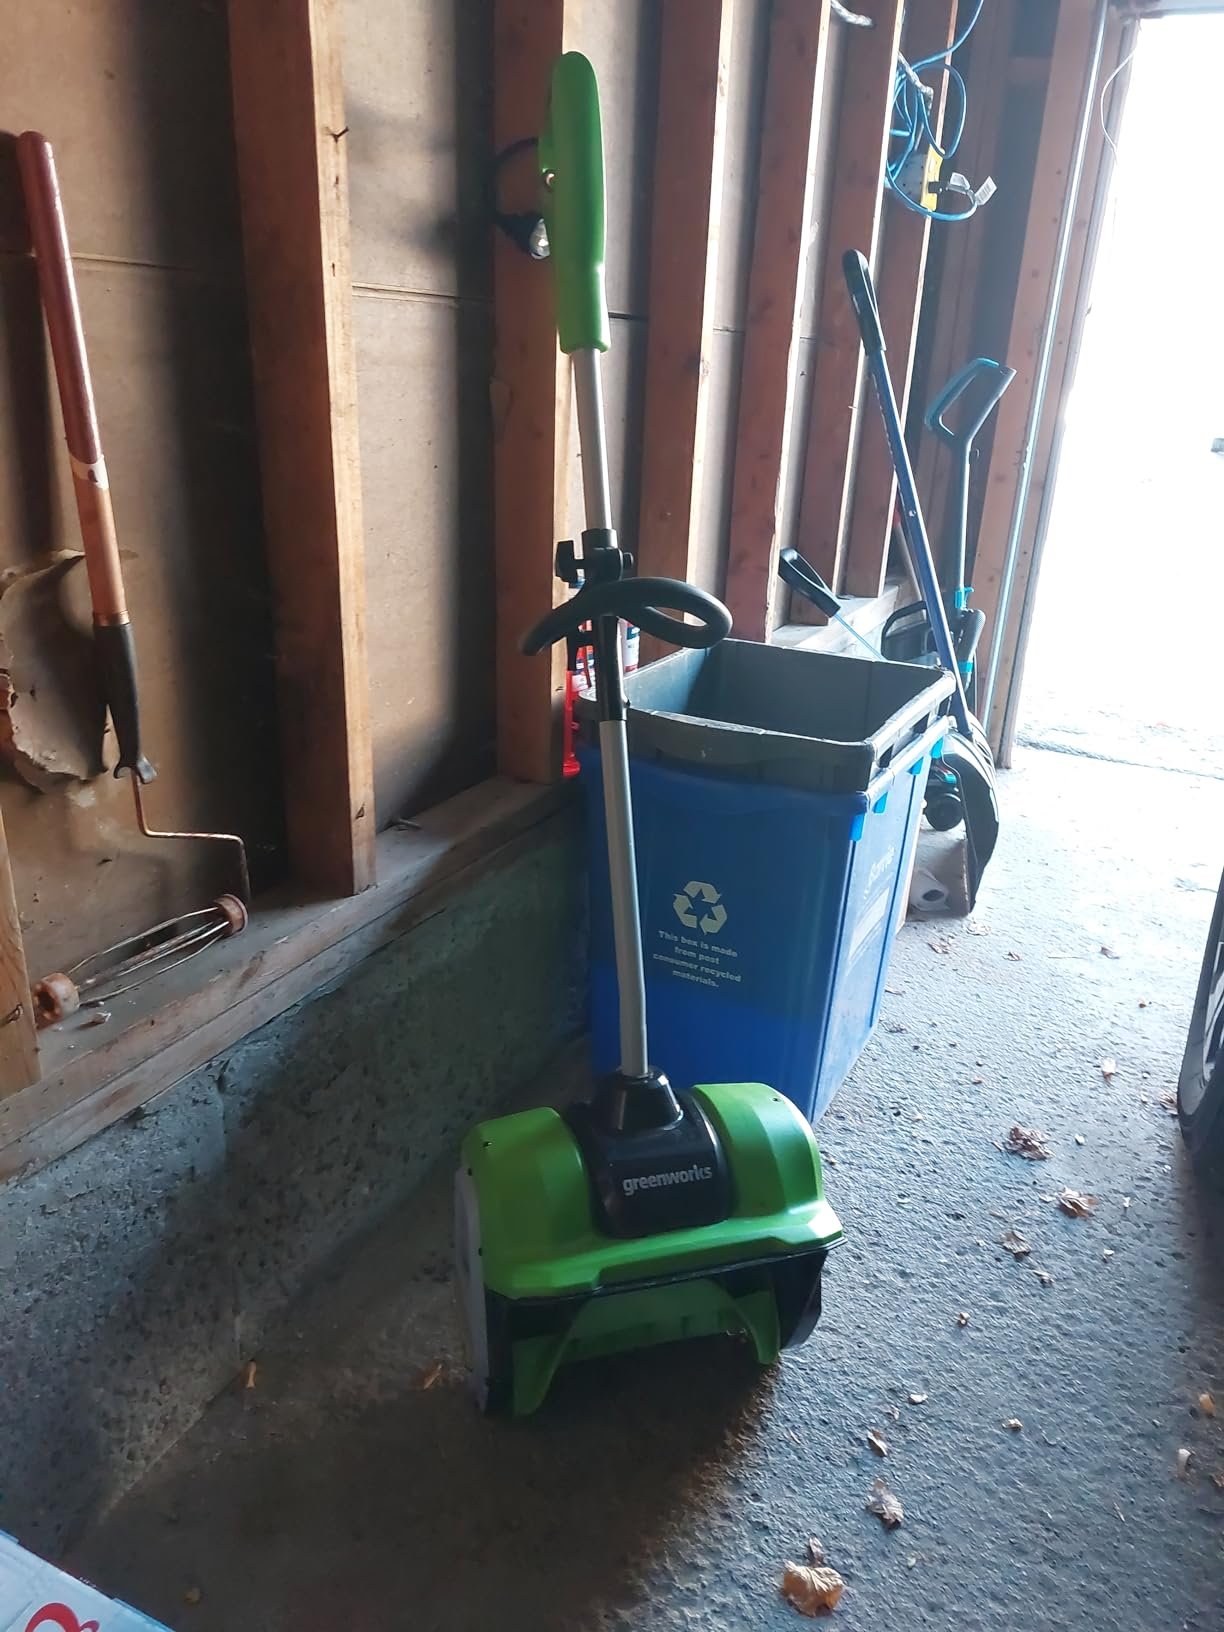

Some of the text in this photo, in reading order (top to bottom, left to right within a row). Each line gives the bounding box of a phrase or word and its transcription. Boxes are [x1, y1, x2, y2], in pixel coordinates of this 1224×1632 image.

[659, 930, 738, 958] This box is made
[674, 946, 720, 965] from post
[653, 953, 742, 982] consumer recycled
[672, 970, 720, 988] materials.
[622, 1164, 713, 1196] greenworks
